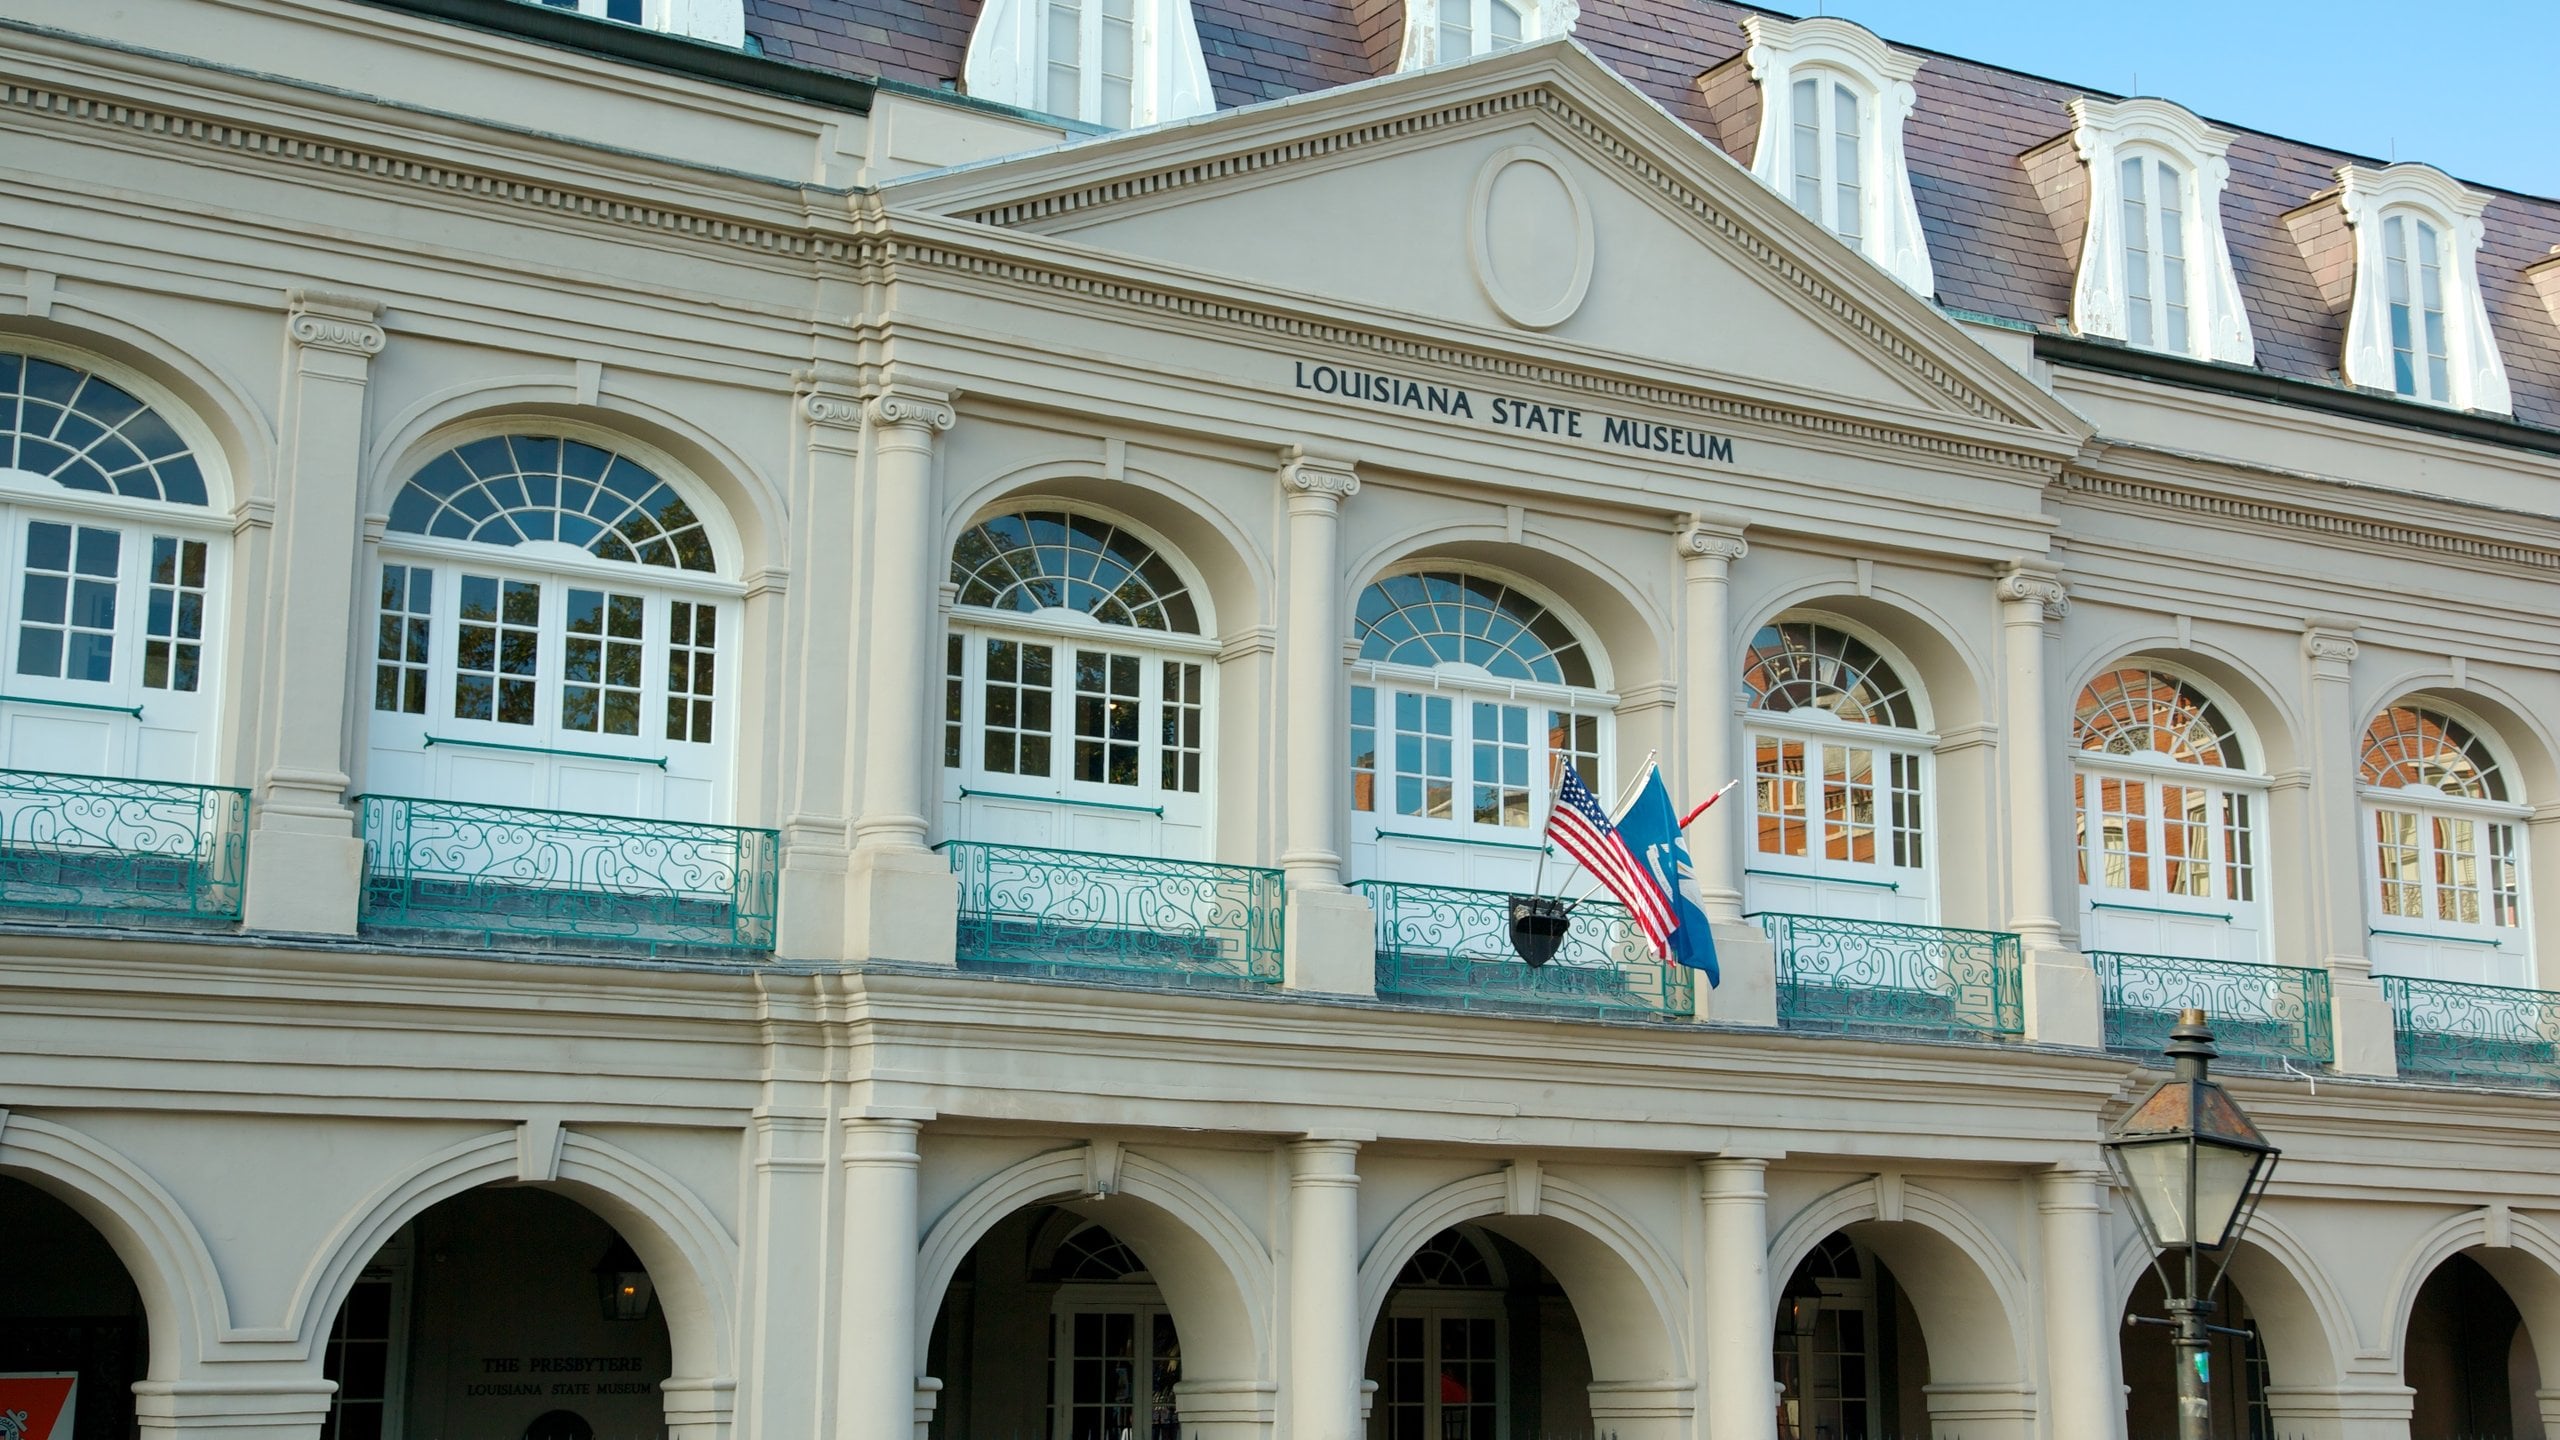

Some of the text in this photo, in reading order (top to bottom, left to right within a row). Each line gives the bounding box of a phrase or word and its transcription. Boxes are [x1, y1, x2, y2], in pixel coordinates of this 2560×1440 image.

[1295, 361, 1734, 464] LOUISIANA STATE MUSEUM
[482, 1357, 643, 1373] THE PRESBYTERE
[467, 1383, 651, 1396] LOUISIANA STATE MUSEUM
